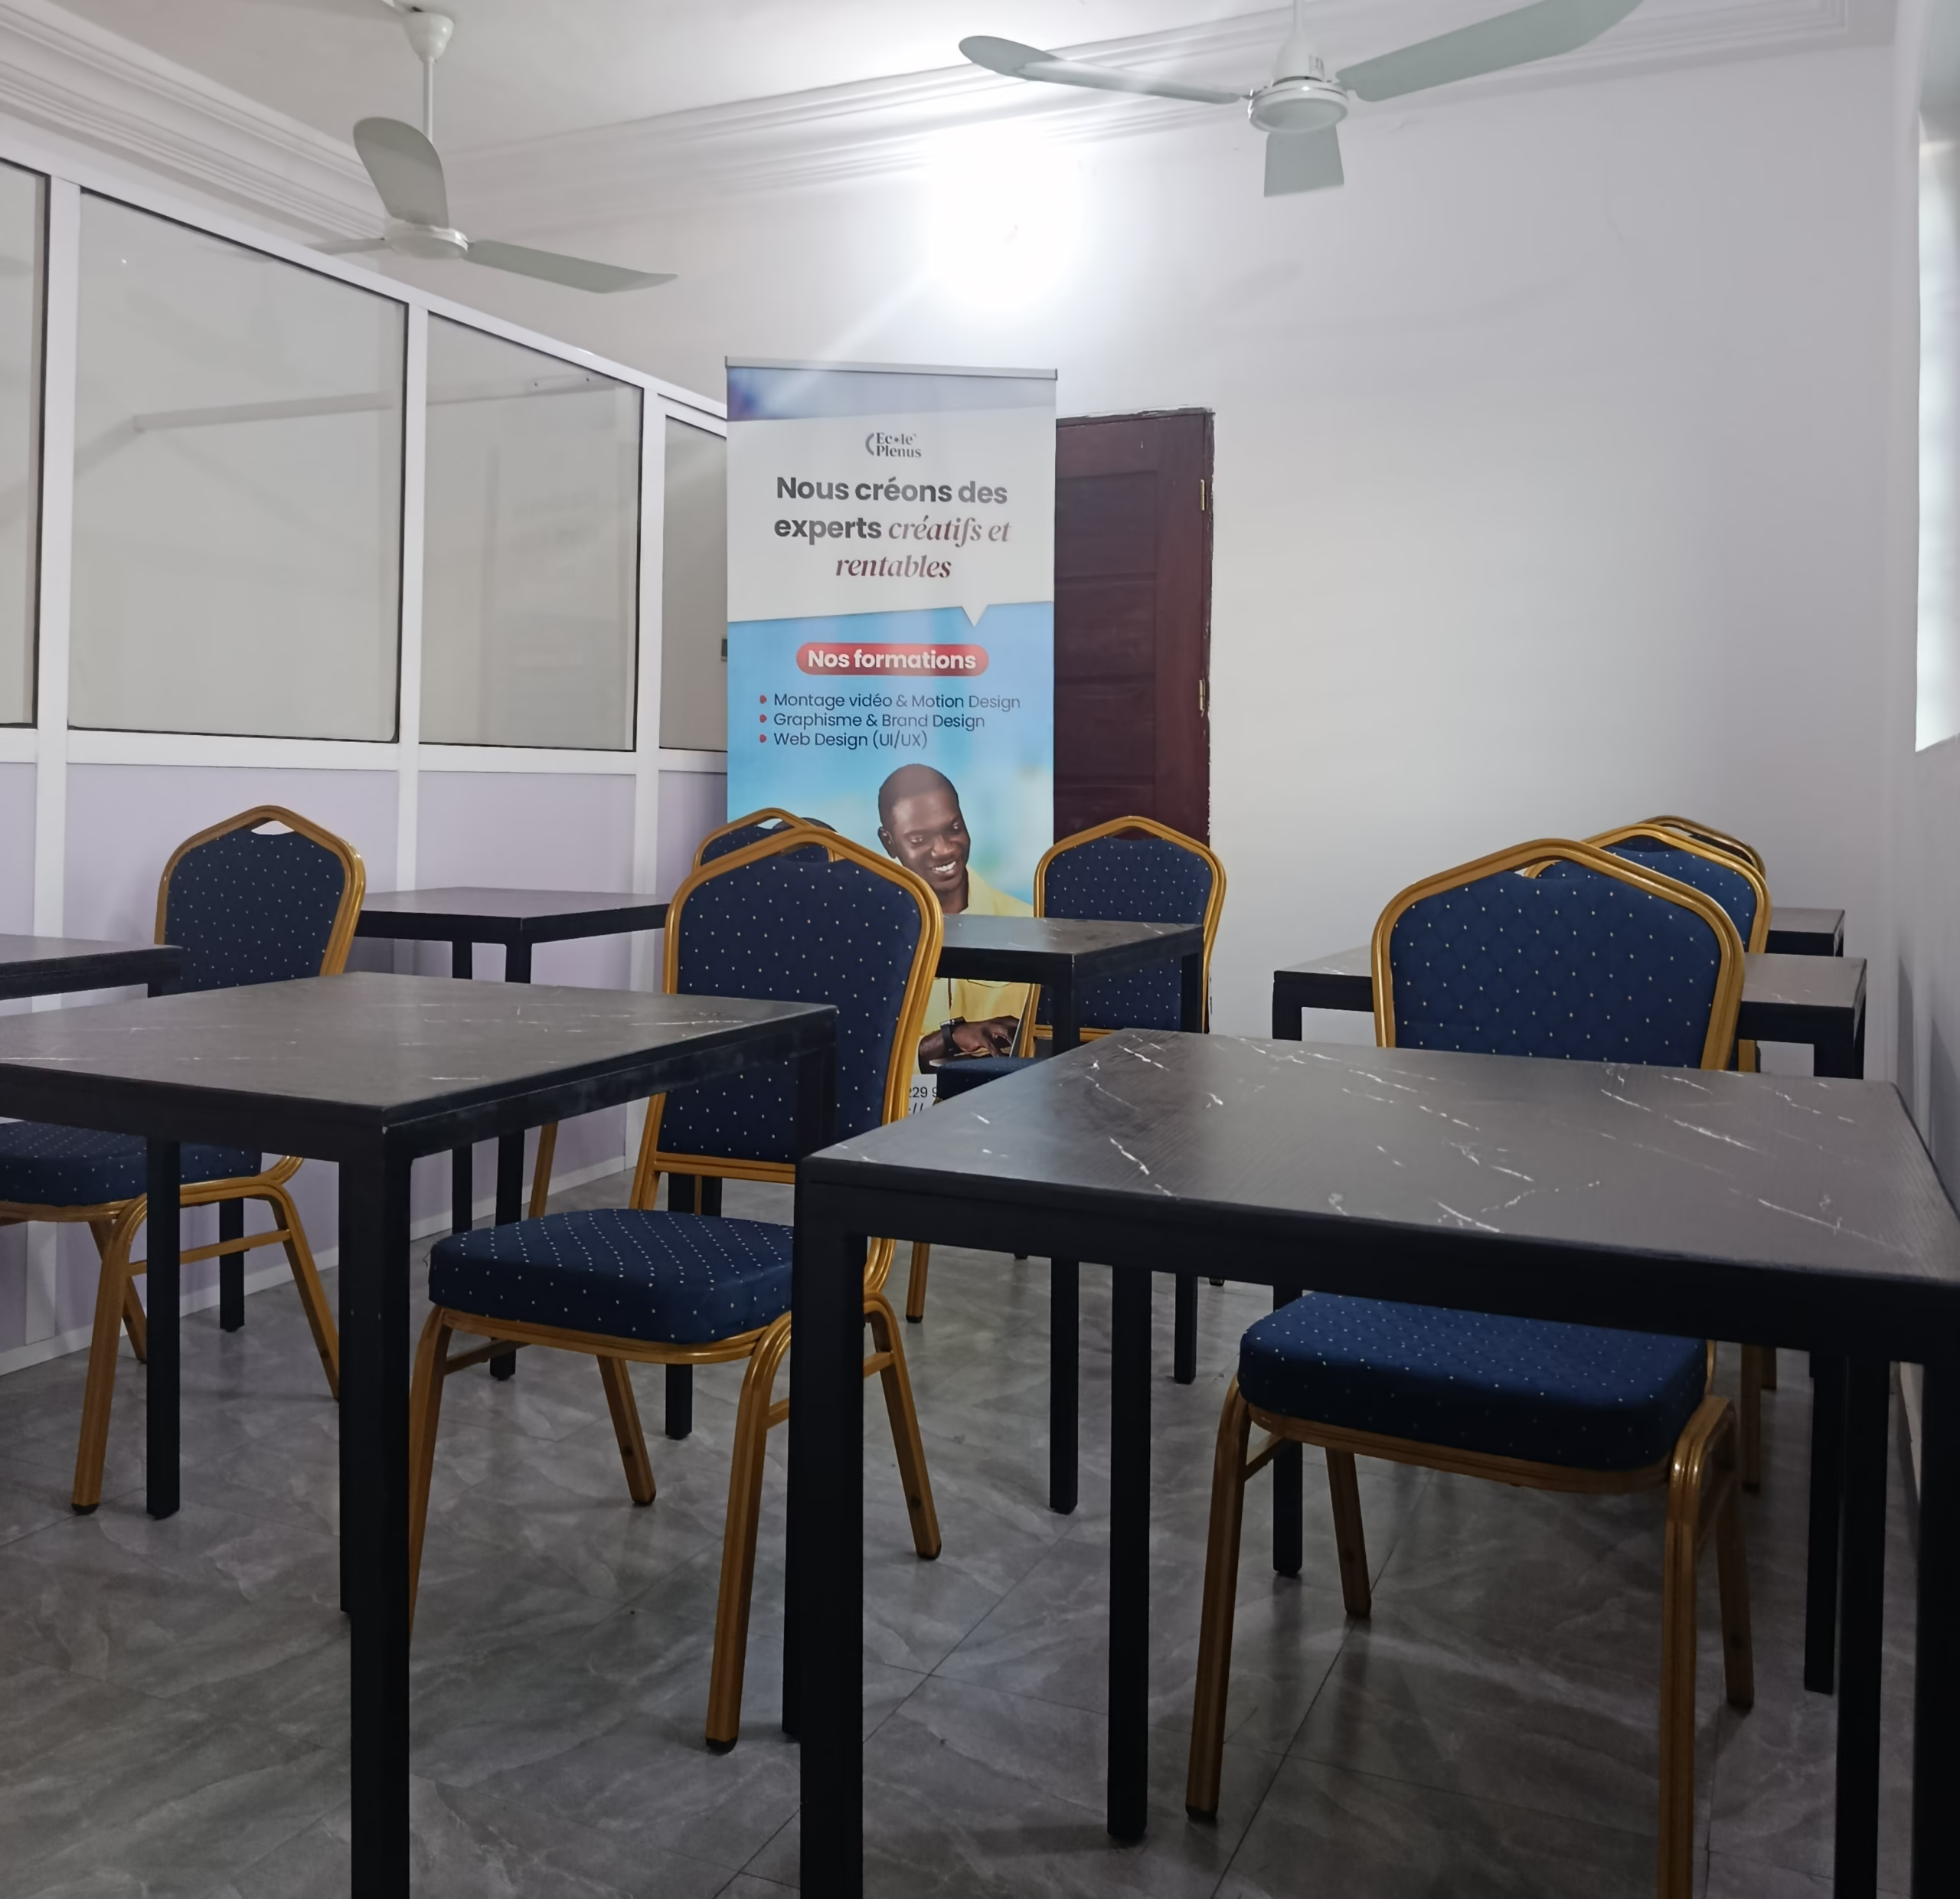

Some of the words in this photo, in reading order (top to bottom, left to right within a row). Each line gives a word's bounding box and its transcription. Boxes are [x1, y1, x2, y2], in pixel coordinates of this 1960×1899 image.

[876, 445, 922, 459] Plenus
[777, 477, 849, 500] Nous
[855, 476, 952, 502] créons
[959, 481, 1008, 504] des
[774, 518, 882, 545] experts
[888, 515, 982, 547] créatifs
[988, 521, 1011, 542] et
[835, 554, 952, 578] rentables
[808, 650, 850, 668] Nos
[854, 649, 976, 669] formations
[774, 694, 845, 711] Montage
[849, 693, 892, 708] vidéo
[896, 695, 908, 708] &
[912, 695, 964, 708] Motion
[969, 695, 1021, 712] Design
[774, 713, 862, 730] Graphisme
[867, 714, 878, 727] &
[882, 714, 928, 727] Brand
[933, 714, 985, 731] Design
[774, 733, 810, 747] Web
[815, 733, 867, 750] Design
[873, 731, 927, 750] (UI/UX)
[909, 1087, 928, 1098] 29
